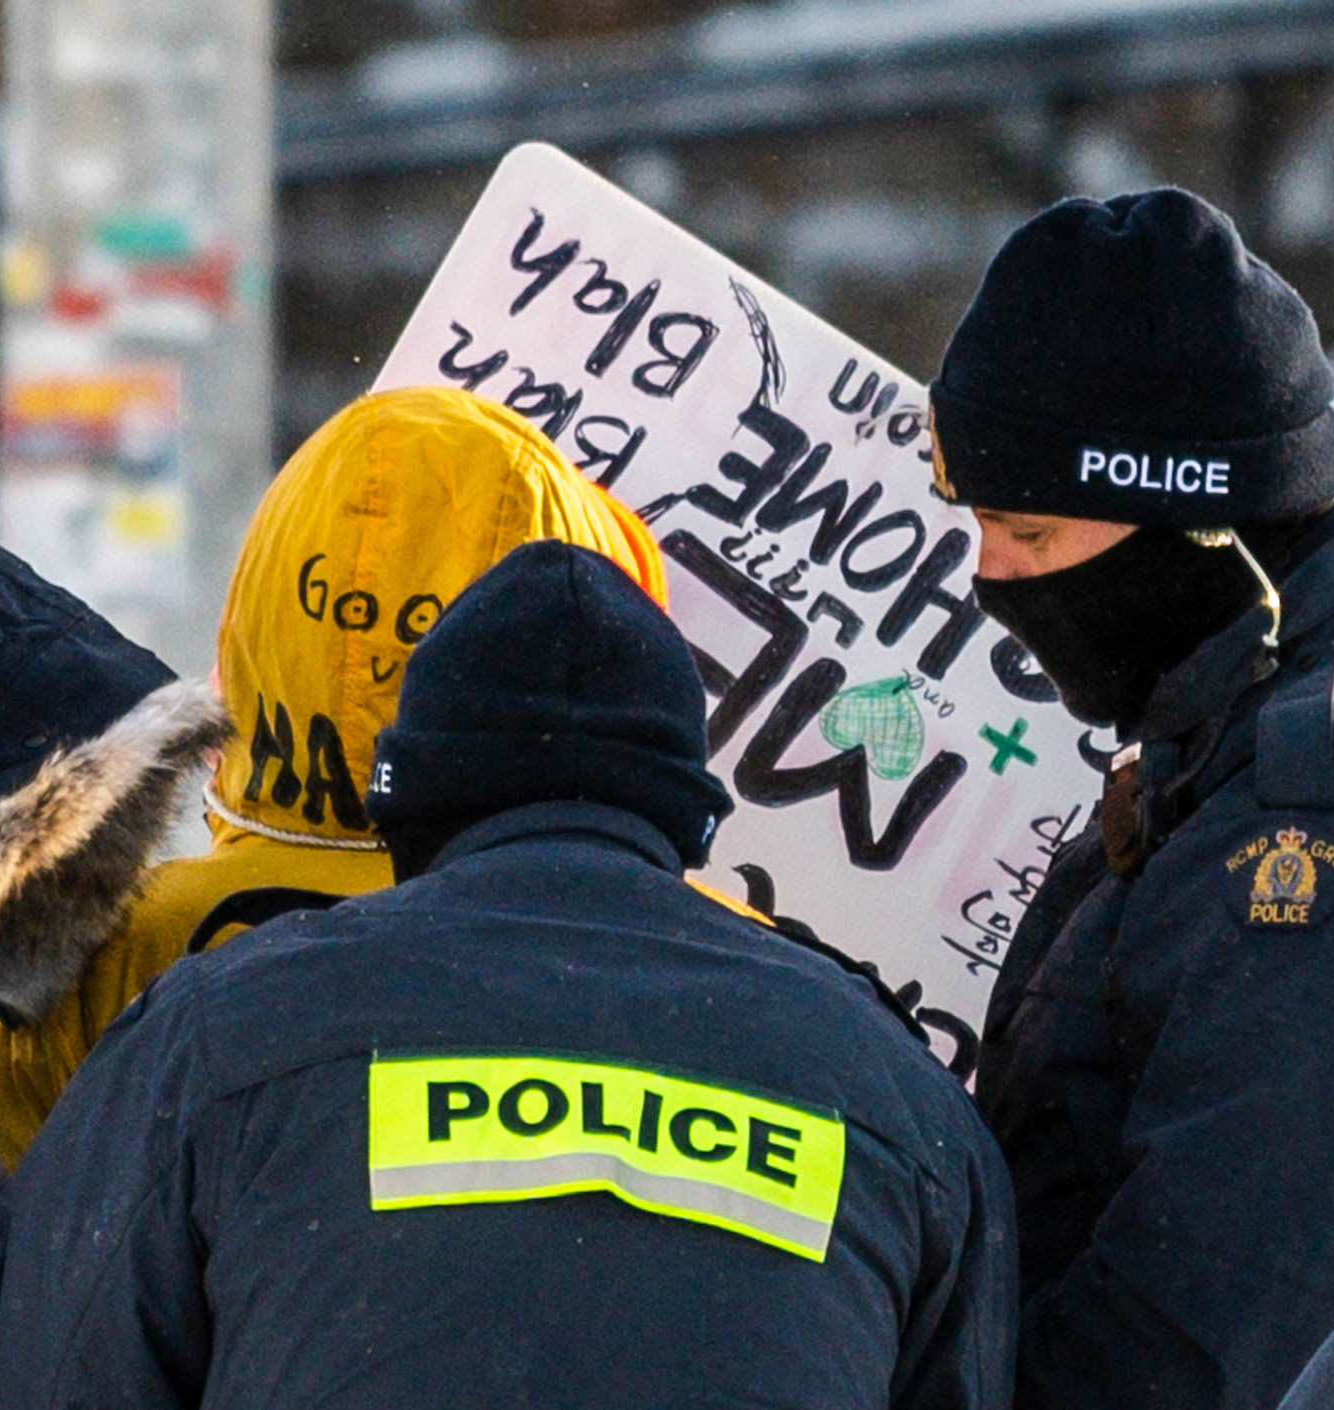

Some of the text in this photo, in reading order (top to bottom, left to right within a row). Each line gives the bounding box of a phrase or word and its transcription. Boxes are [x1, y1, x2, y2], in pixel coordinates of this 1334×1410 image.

[511, 206, 720, 401] Blah
[1080, 449, 1231, 494] POLICE
[685, 402, 987, 681] HOME
[1225, 836, 1269, 874] RCMP
[1249, 903, 1311, 924] POLICE
[426, 1077, 803, 1189] POLICE
